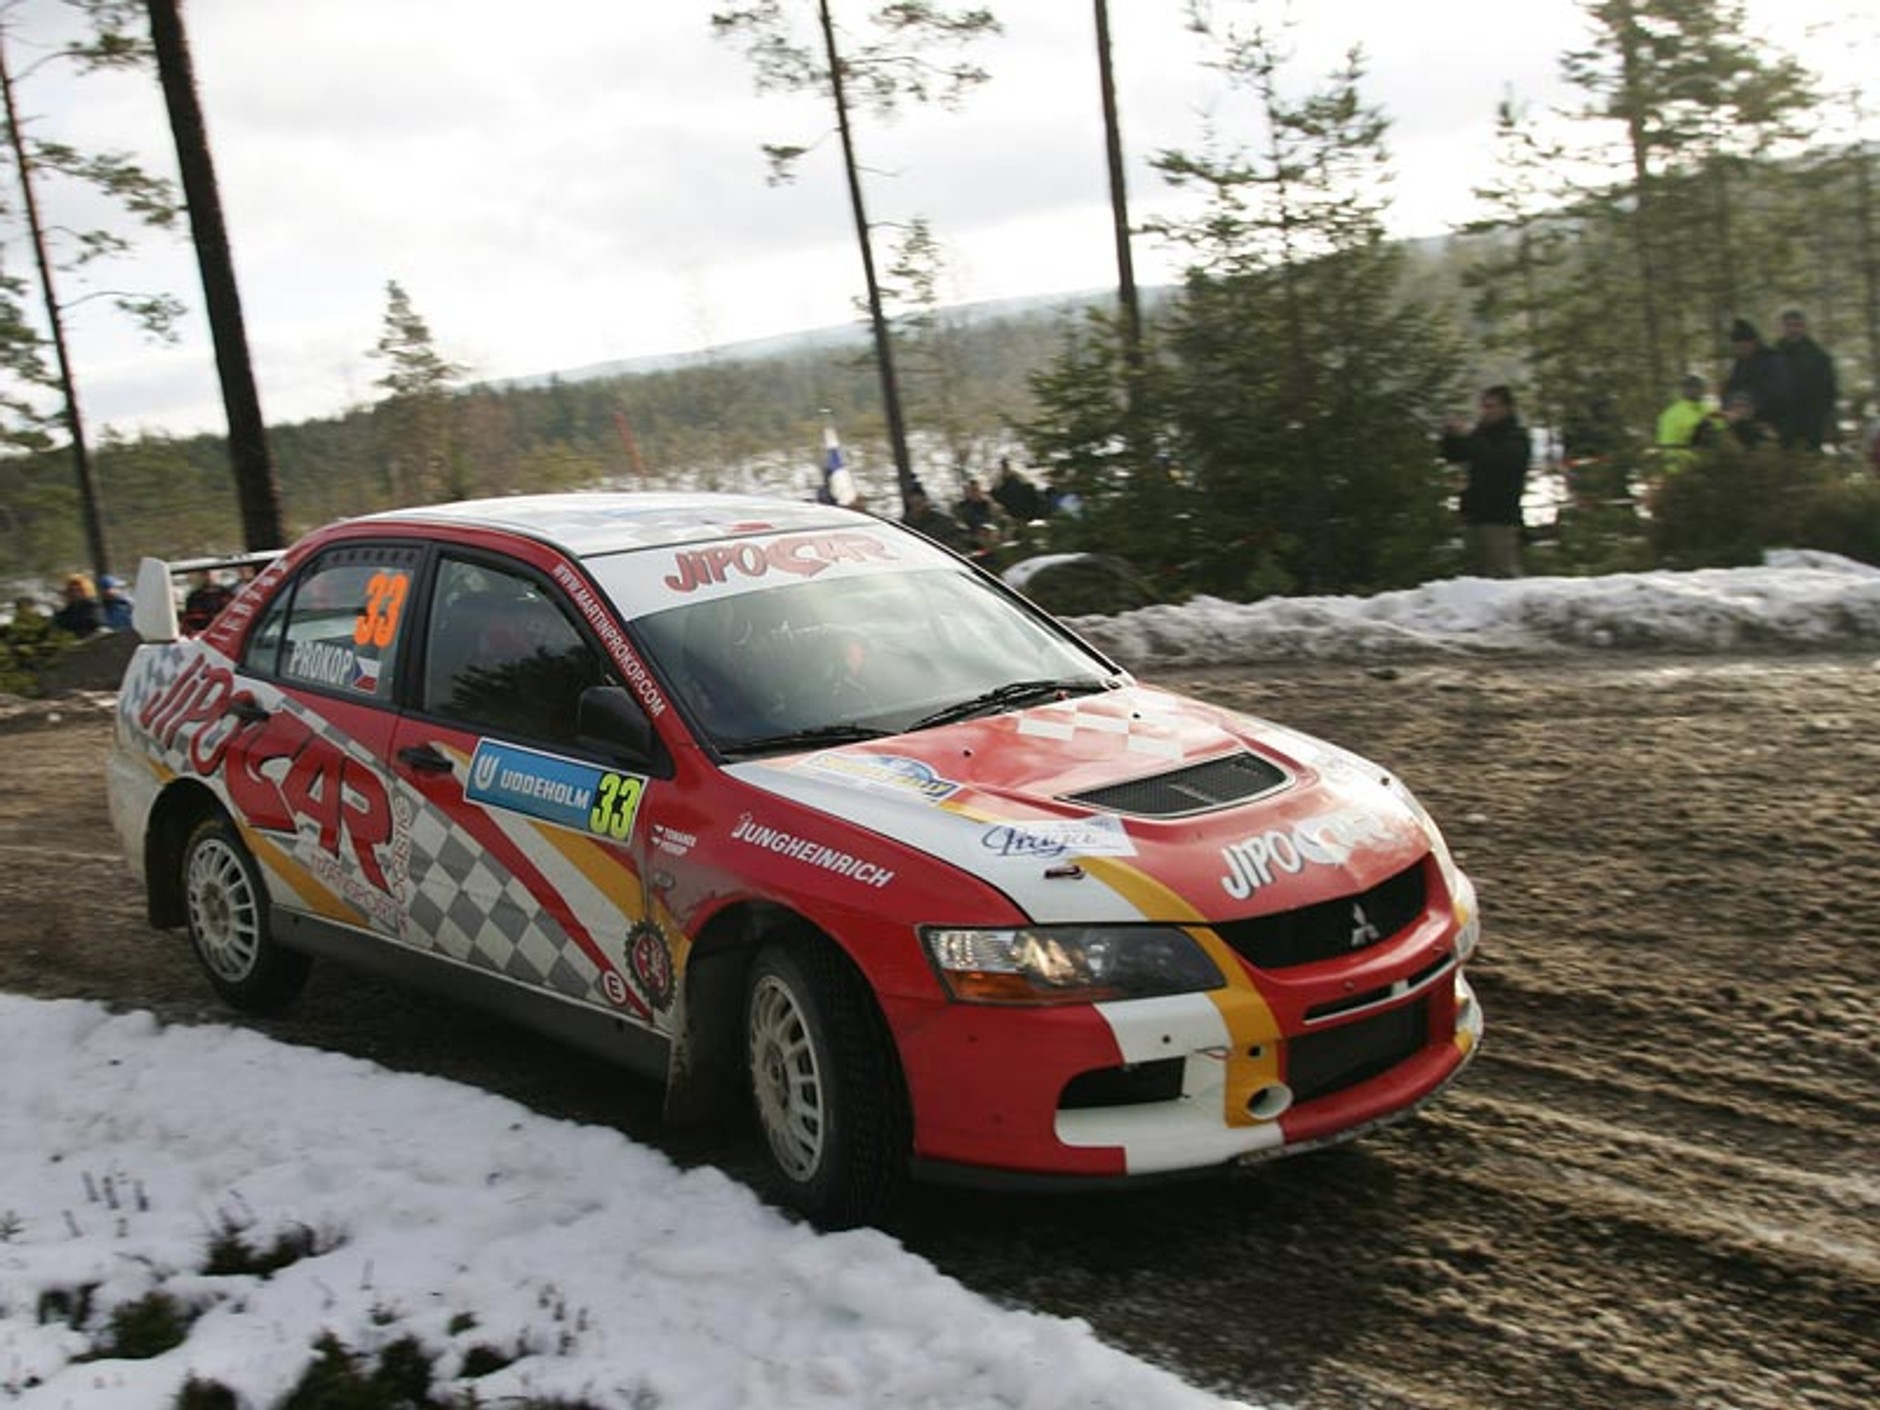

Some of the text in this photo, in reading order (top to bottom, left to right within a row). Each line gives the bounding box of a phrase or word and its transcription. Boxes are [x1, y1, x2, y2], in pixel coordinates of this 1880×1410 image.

[664, 533, 899, 593] JIPOCAR
[354, 571, 410, 648] 33
[555, 563, 667, 717] WWW.MARTINPROKOP.COM
[288, 640, 355, 685] PROKOP
[139, 653, 395, 899] JIPOCAR
[500, 769, 592, 809] UDDEHOLM
[590, 772, 642, 840] 33
[731, 811, 895, 888] JUNGHEINRICH
